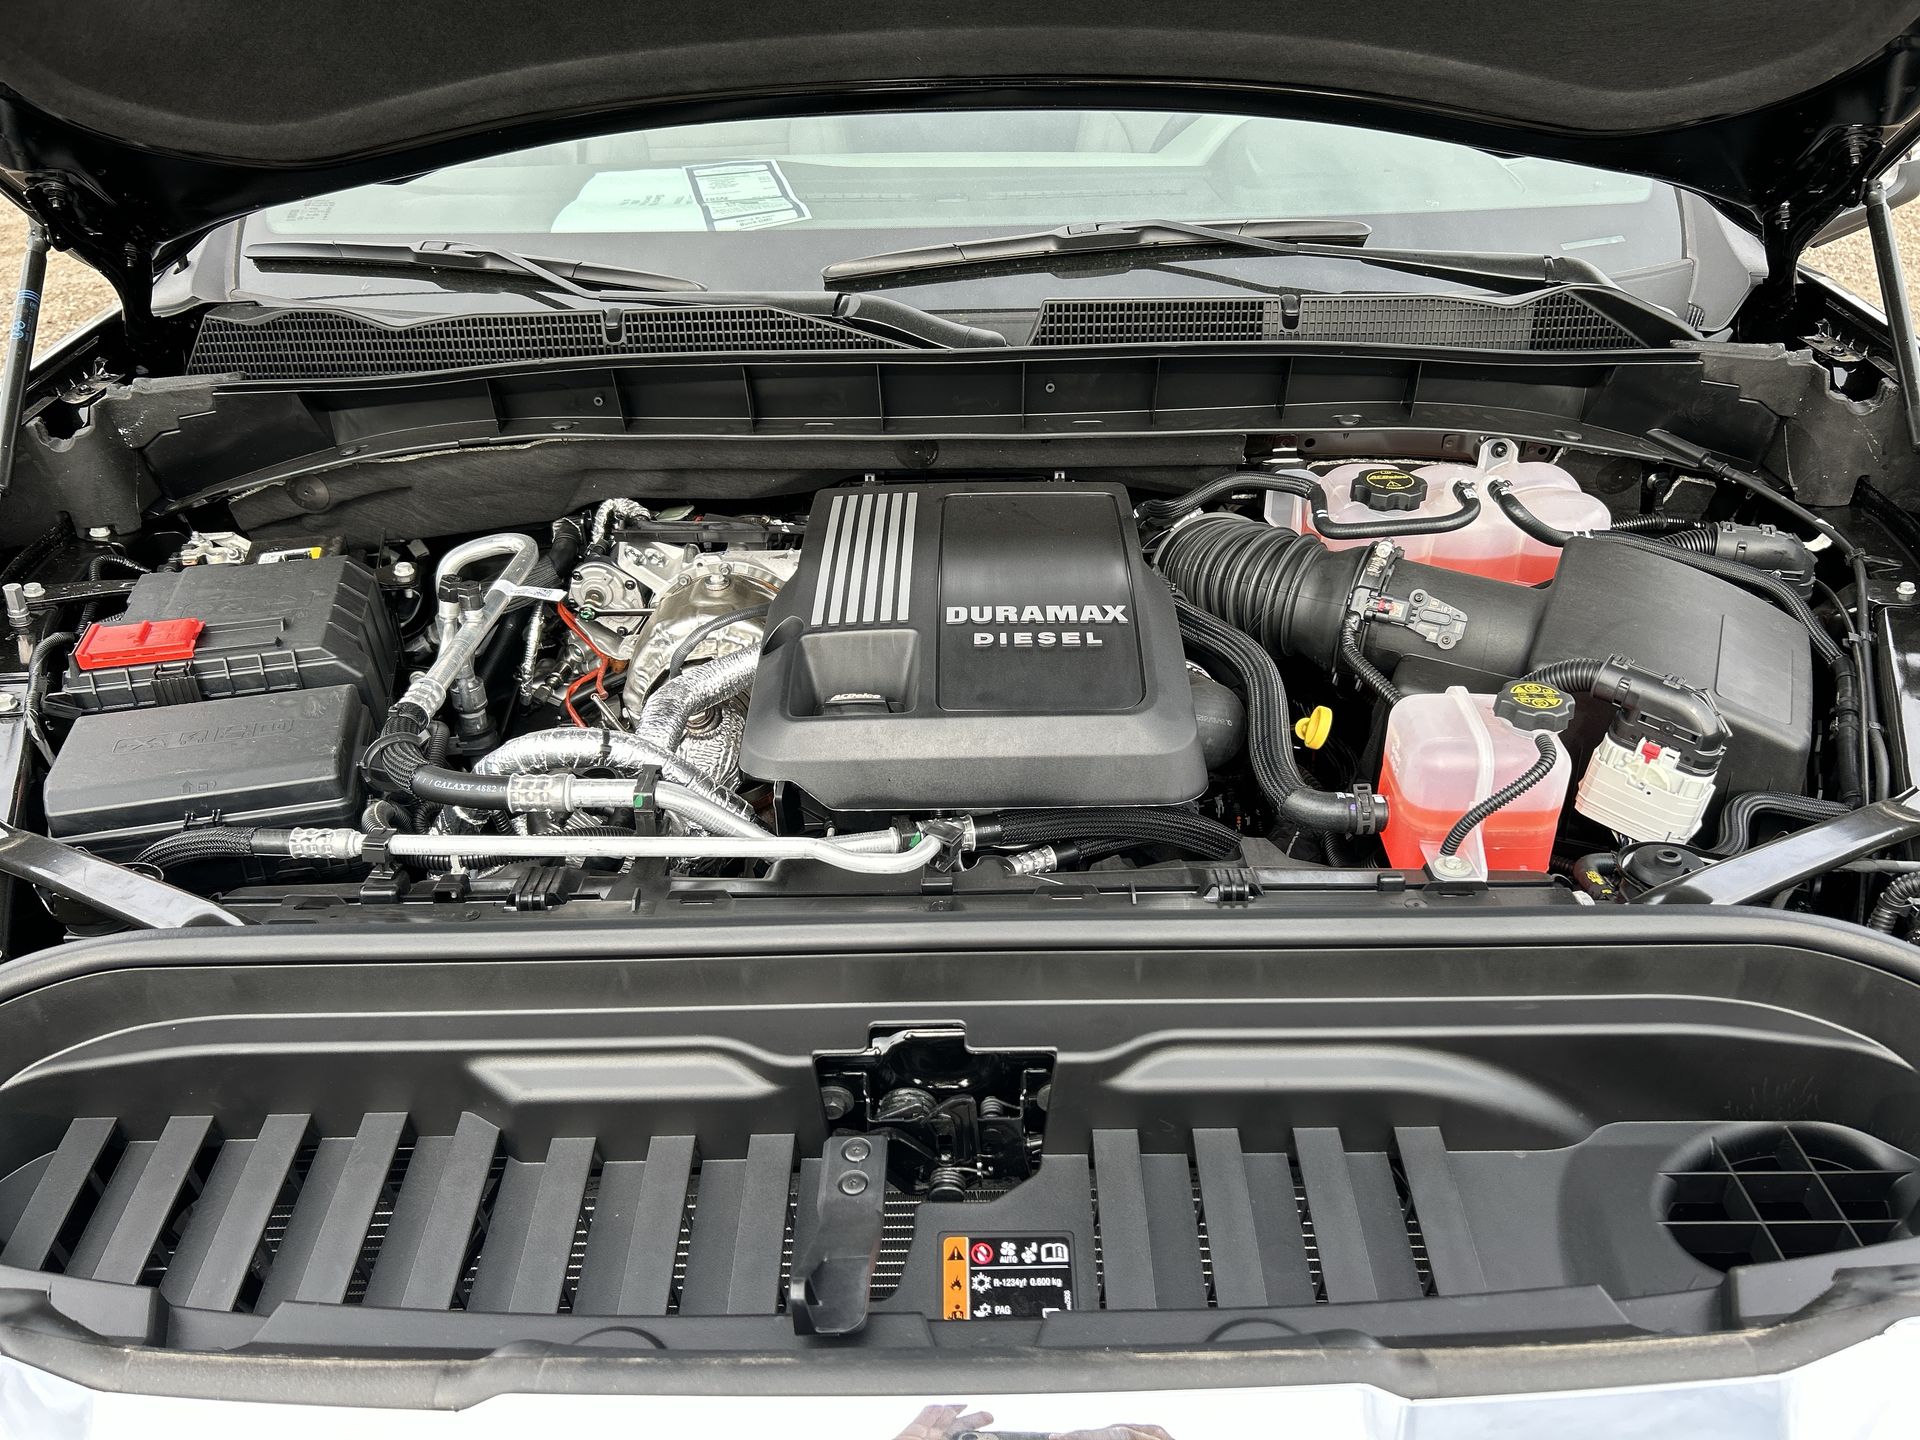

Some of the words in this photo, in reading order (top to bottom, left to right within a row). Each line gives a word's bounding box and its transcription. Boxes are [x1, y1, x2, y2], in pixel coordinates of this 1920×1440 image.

[946, 605, 1129, 625] DURAMAX
[973, 632, 1103, 647] DIESEL
[434, 780, 475, 792] GALAXY
[999, 1255, 1018, 1264] AUTO
[1051, 1277, 1063, 1288] kg
[994, 1305, 1012, 1315] PAG
